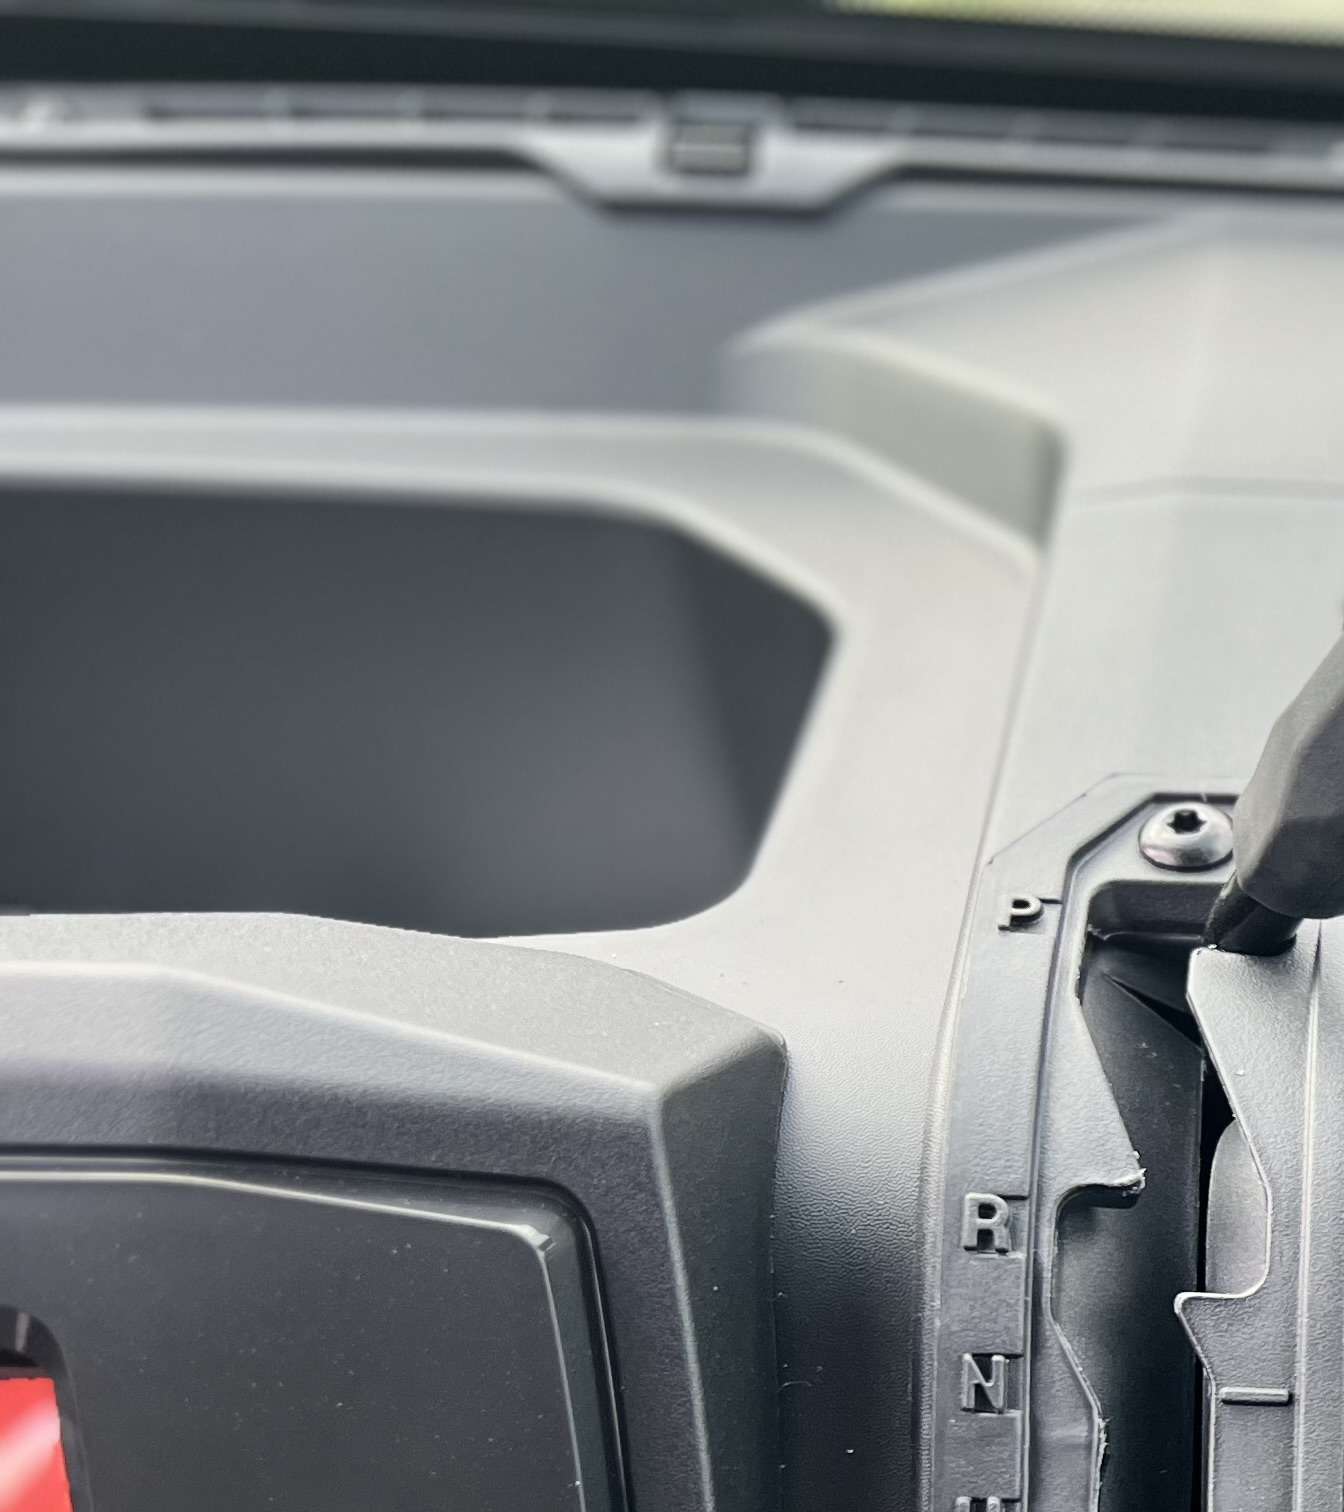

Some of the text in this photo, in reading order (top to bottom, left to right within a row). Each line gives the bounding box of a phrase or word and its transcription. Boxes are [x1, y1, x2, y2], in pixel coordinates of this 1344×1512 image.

[999, 896, 1045, 931] P
[963, 1192, 1013, 1253] R
[961, 1352, 1006, 1413] N
